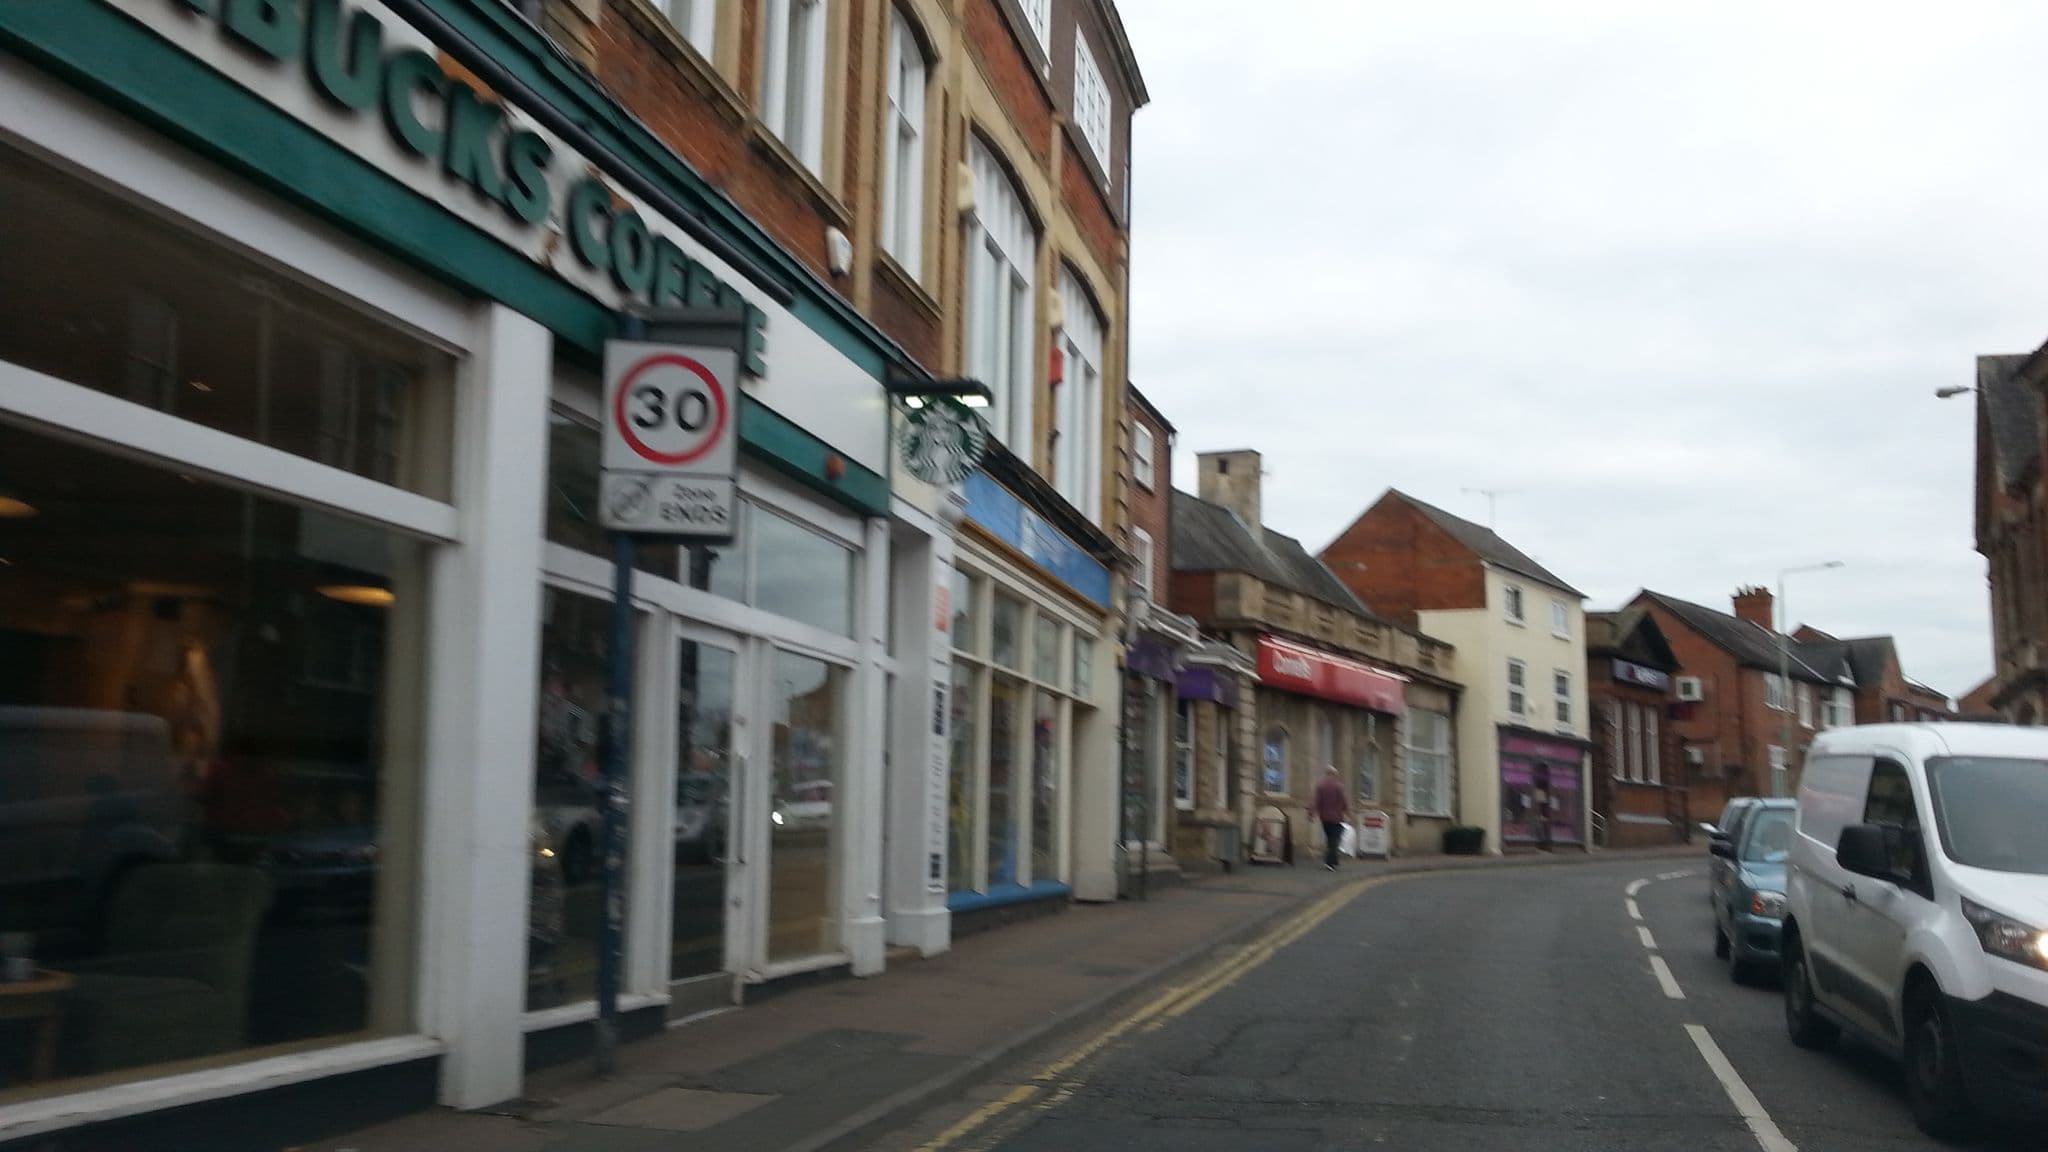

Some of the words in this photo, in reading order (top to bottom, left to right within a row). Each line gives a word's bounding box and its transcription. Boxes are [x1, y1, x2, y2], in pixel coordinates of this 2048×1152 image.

[168, 0, 553, 228] BUCKS
[634, 384, 710, 433] 30
[659, 502, 728, 524] ENDS
